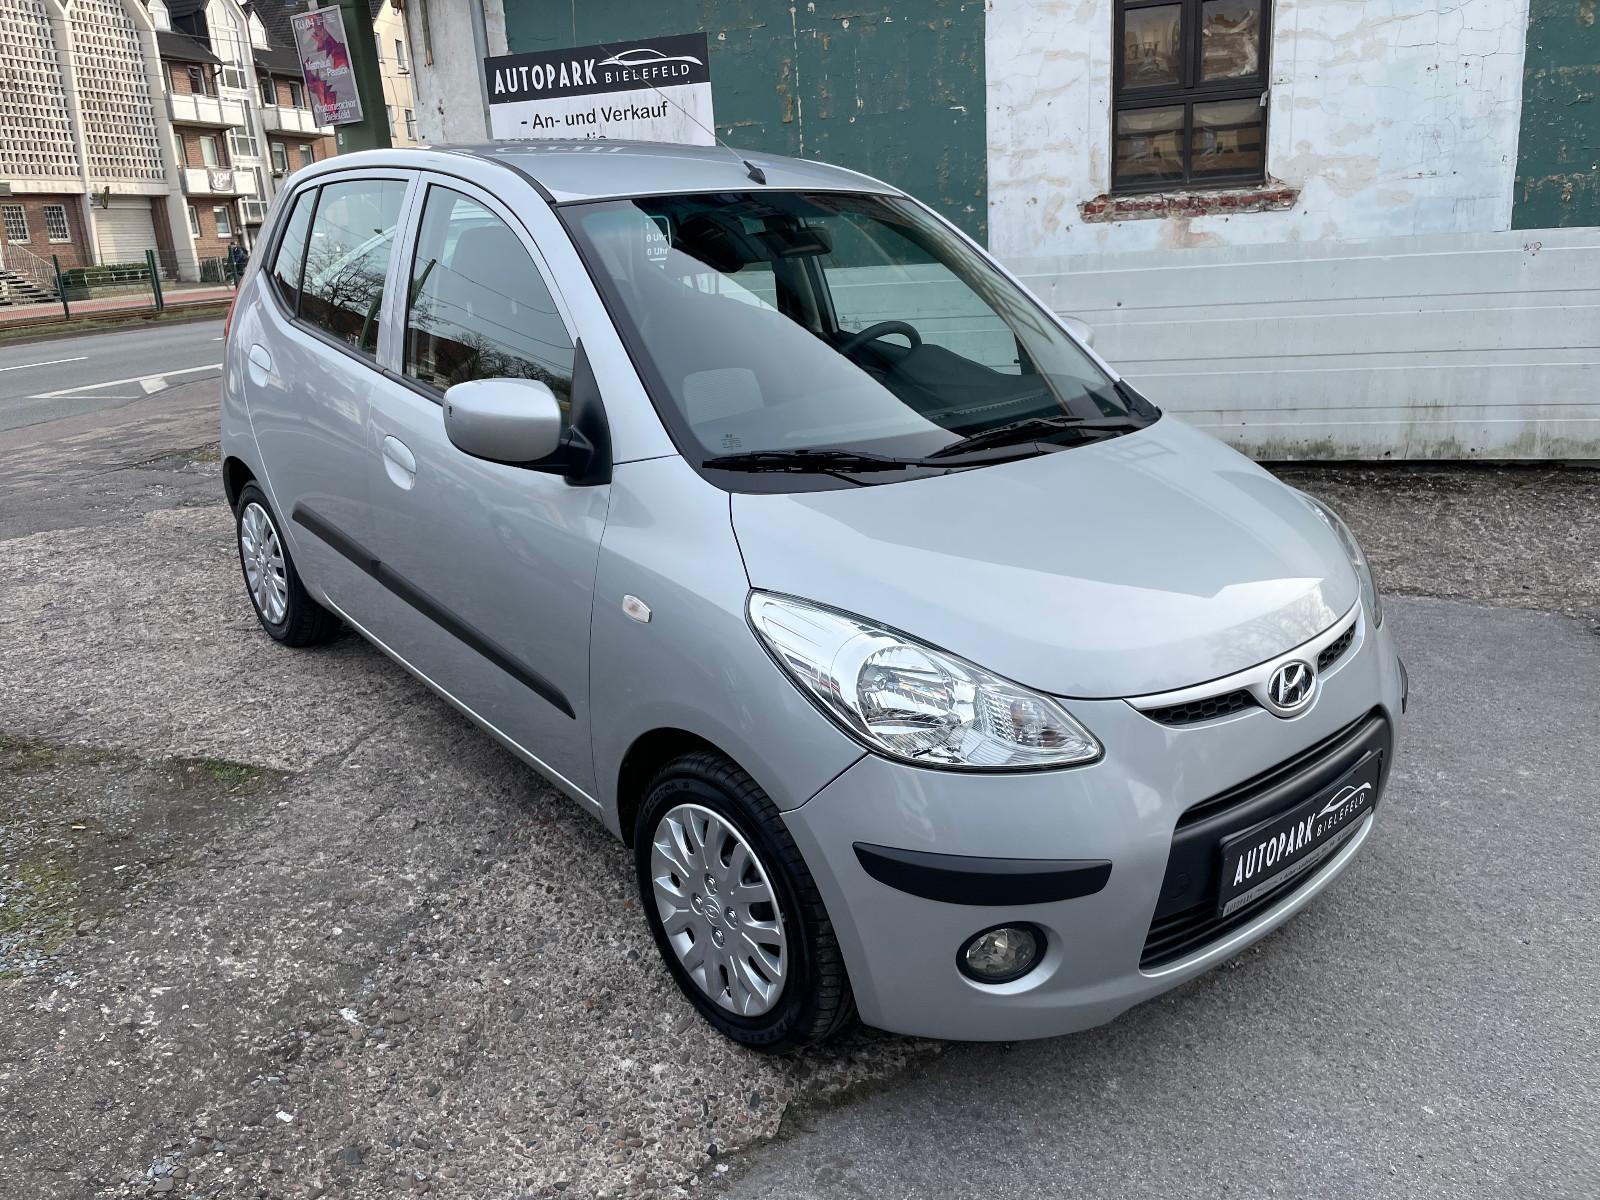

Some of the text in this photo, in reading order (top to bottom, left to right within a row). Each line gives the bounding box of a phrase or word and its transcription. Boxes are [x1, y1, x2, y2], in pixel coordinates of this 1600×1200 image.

[494, 58, 690, 95] AUTOPARK BIELEFELD
[532, 113, 561, 130] An-
[565, 111, 597, 126] und
[600, 101, 668, 123] Verkauf
[653, 232, 668, 242] Uhr
[654, 246, 669, 256] Uhr
[1233, 813, 1316, 887] AUTOPARK
[1316, 792, 1366, 837] BIELEFELD
